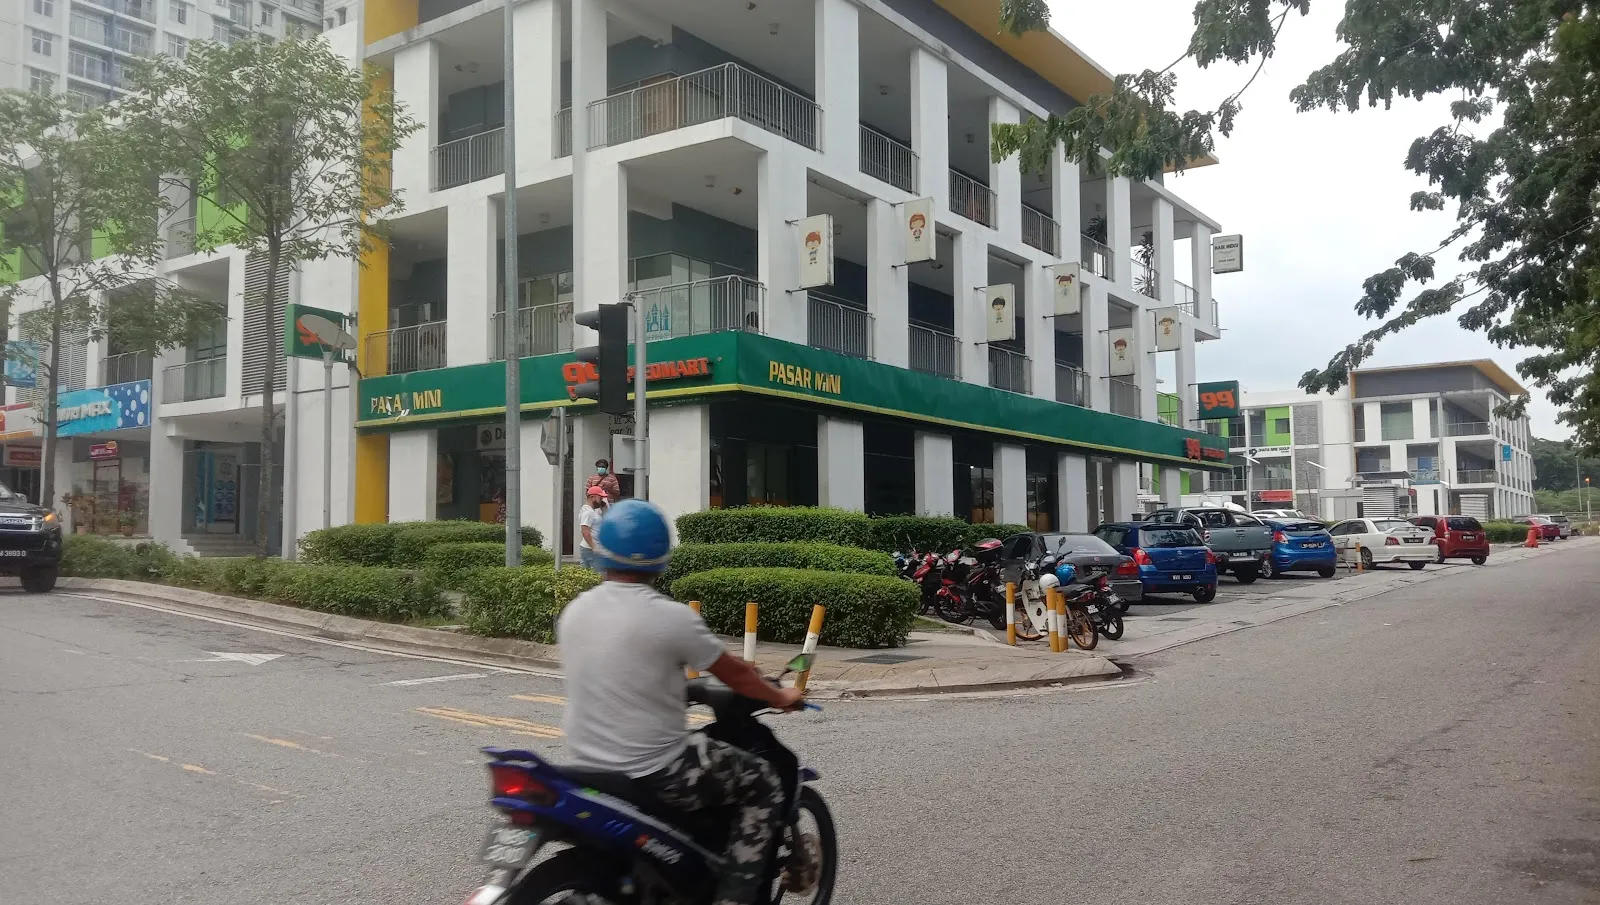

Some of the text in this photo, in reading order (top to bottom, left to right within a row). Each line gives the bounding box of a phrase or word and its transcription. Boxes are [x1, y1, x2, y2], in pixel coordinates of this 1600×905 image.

[769, 361, 841, 394] PASAR MINI
[412, 388, 441, 410] MINI
[1200, 390, 1235, 411] 99
